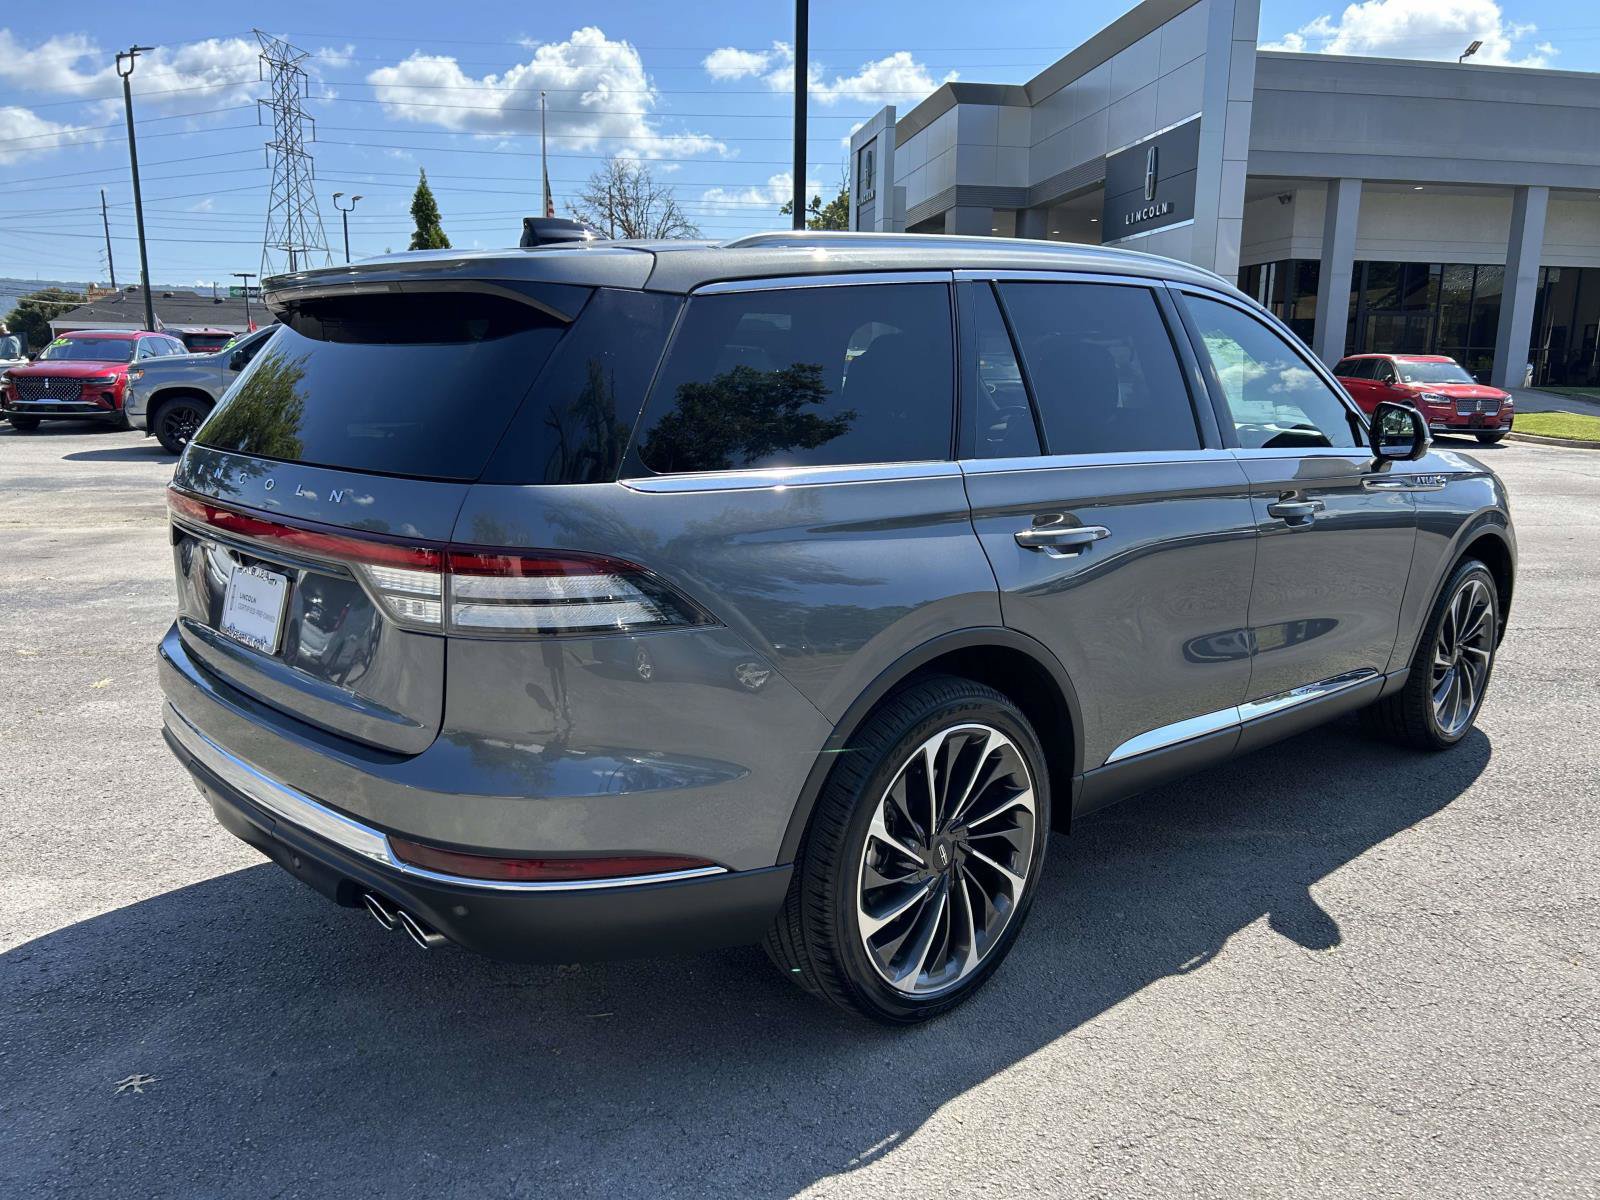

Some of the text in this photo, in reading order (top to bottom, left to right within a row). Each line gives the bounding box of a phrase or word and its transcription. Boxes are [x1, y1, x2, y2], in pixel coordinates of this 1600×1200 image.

[1125, 202, 1168, 225] LINCOLN
[186, 461, 344, 503] INCOLN
[239, 592, 257, 603] LINCOLN
